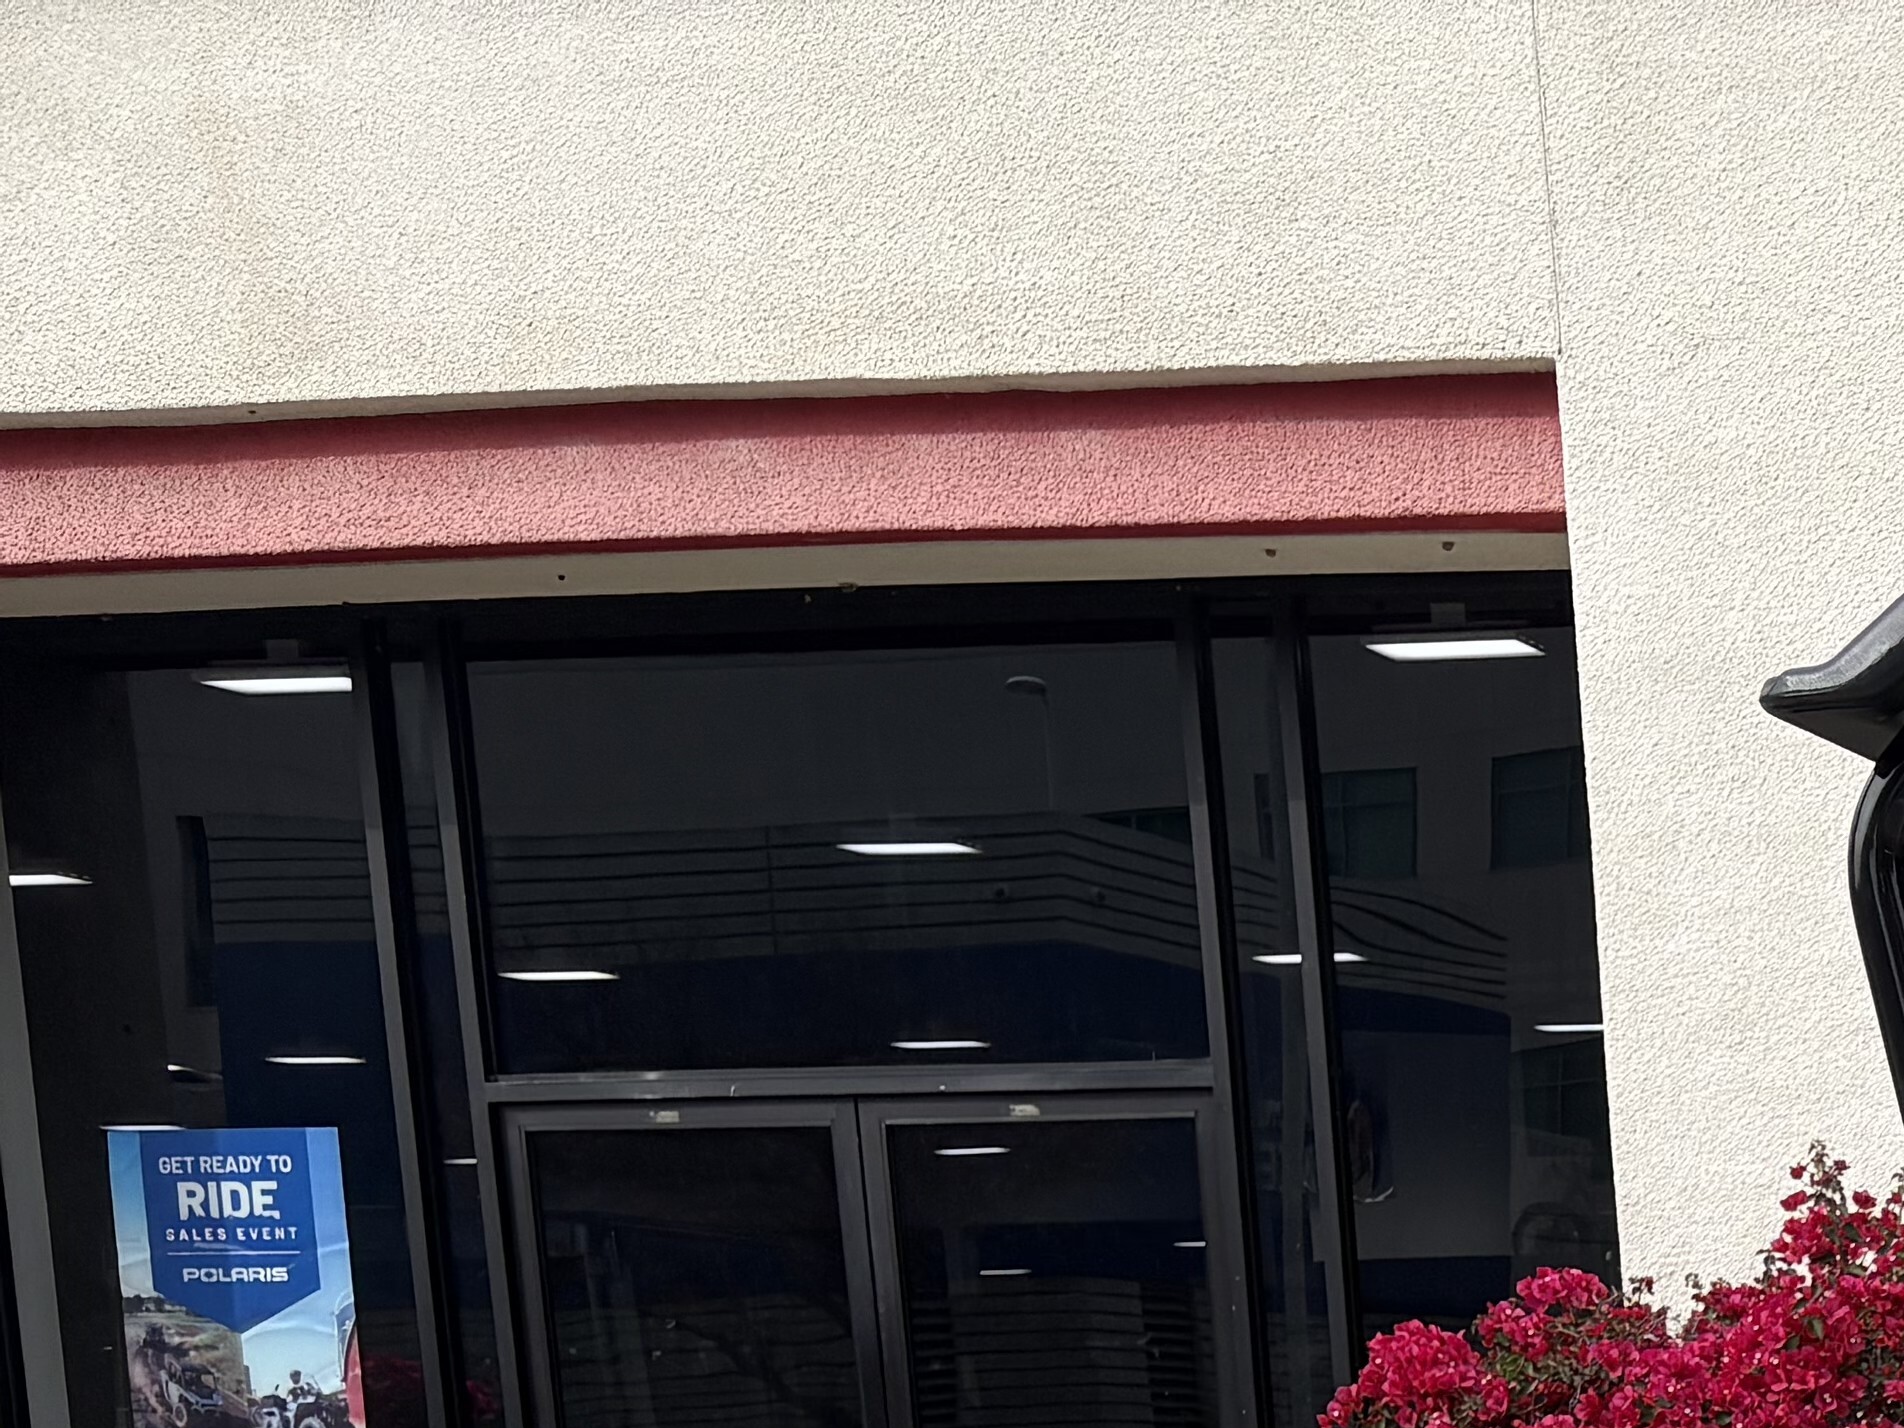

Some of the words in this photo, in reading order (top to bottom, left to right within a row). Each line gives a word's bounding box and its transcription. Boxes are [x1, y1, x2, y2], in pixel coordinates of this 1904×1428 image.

[158, 1156, 194, 1174] GET
[199, 1155, 262, 1174] READY
[266, 1154, 292, 1173] TO
[176, 1180, 281, 1221] RIDE
[166, 1228, 227, 1241] SALES
[236, 1227, 298, 1241] EVENT
[182, 1267, 289, 1283] POLARIS
